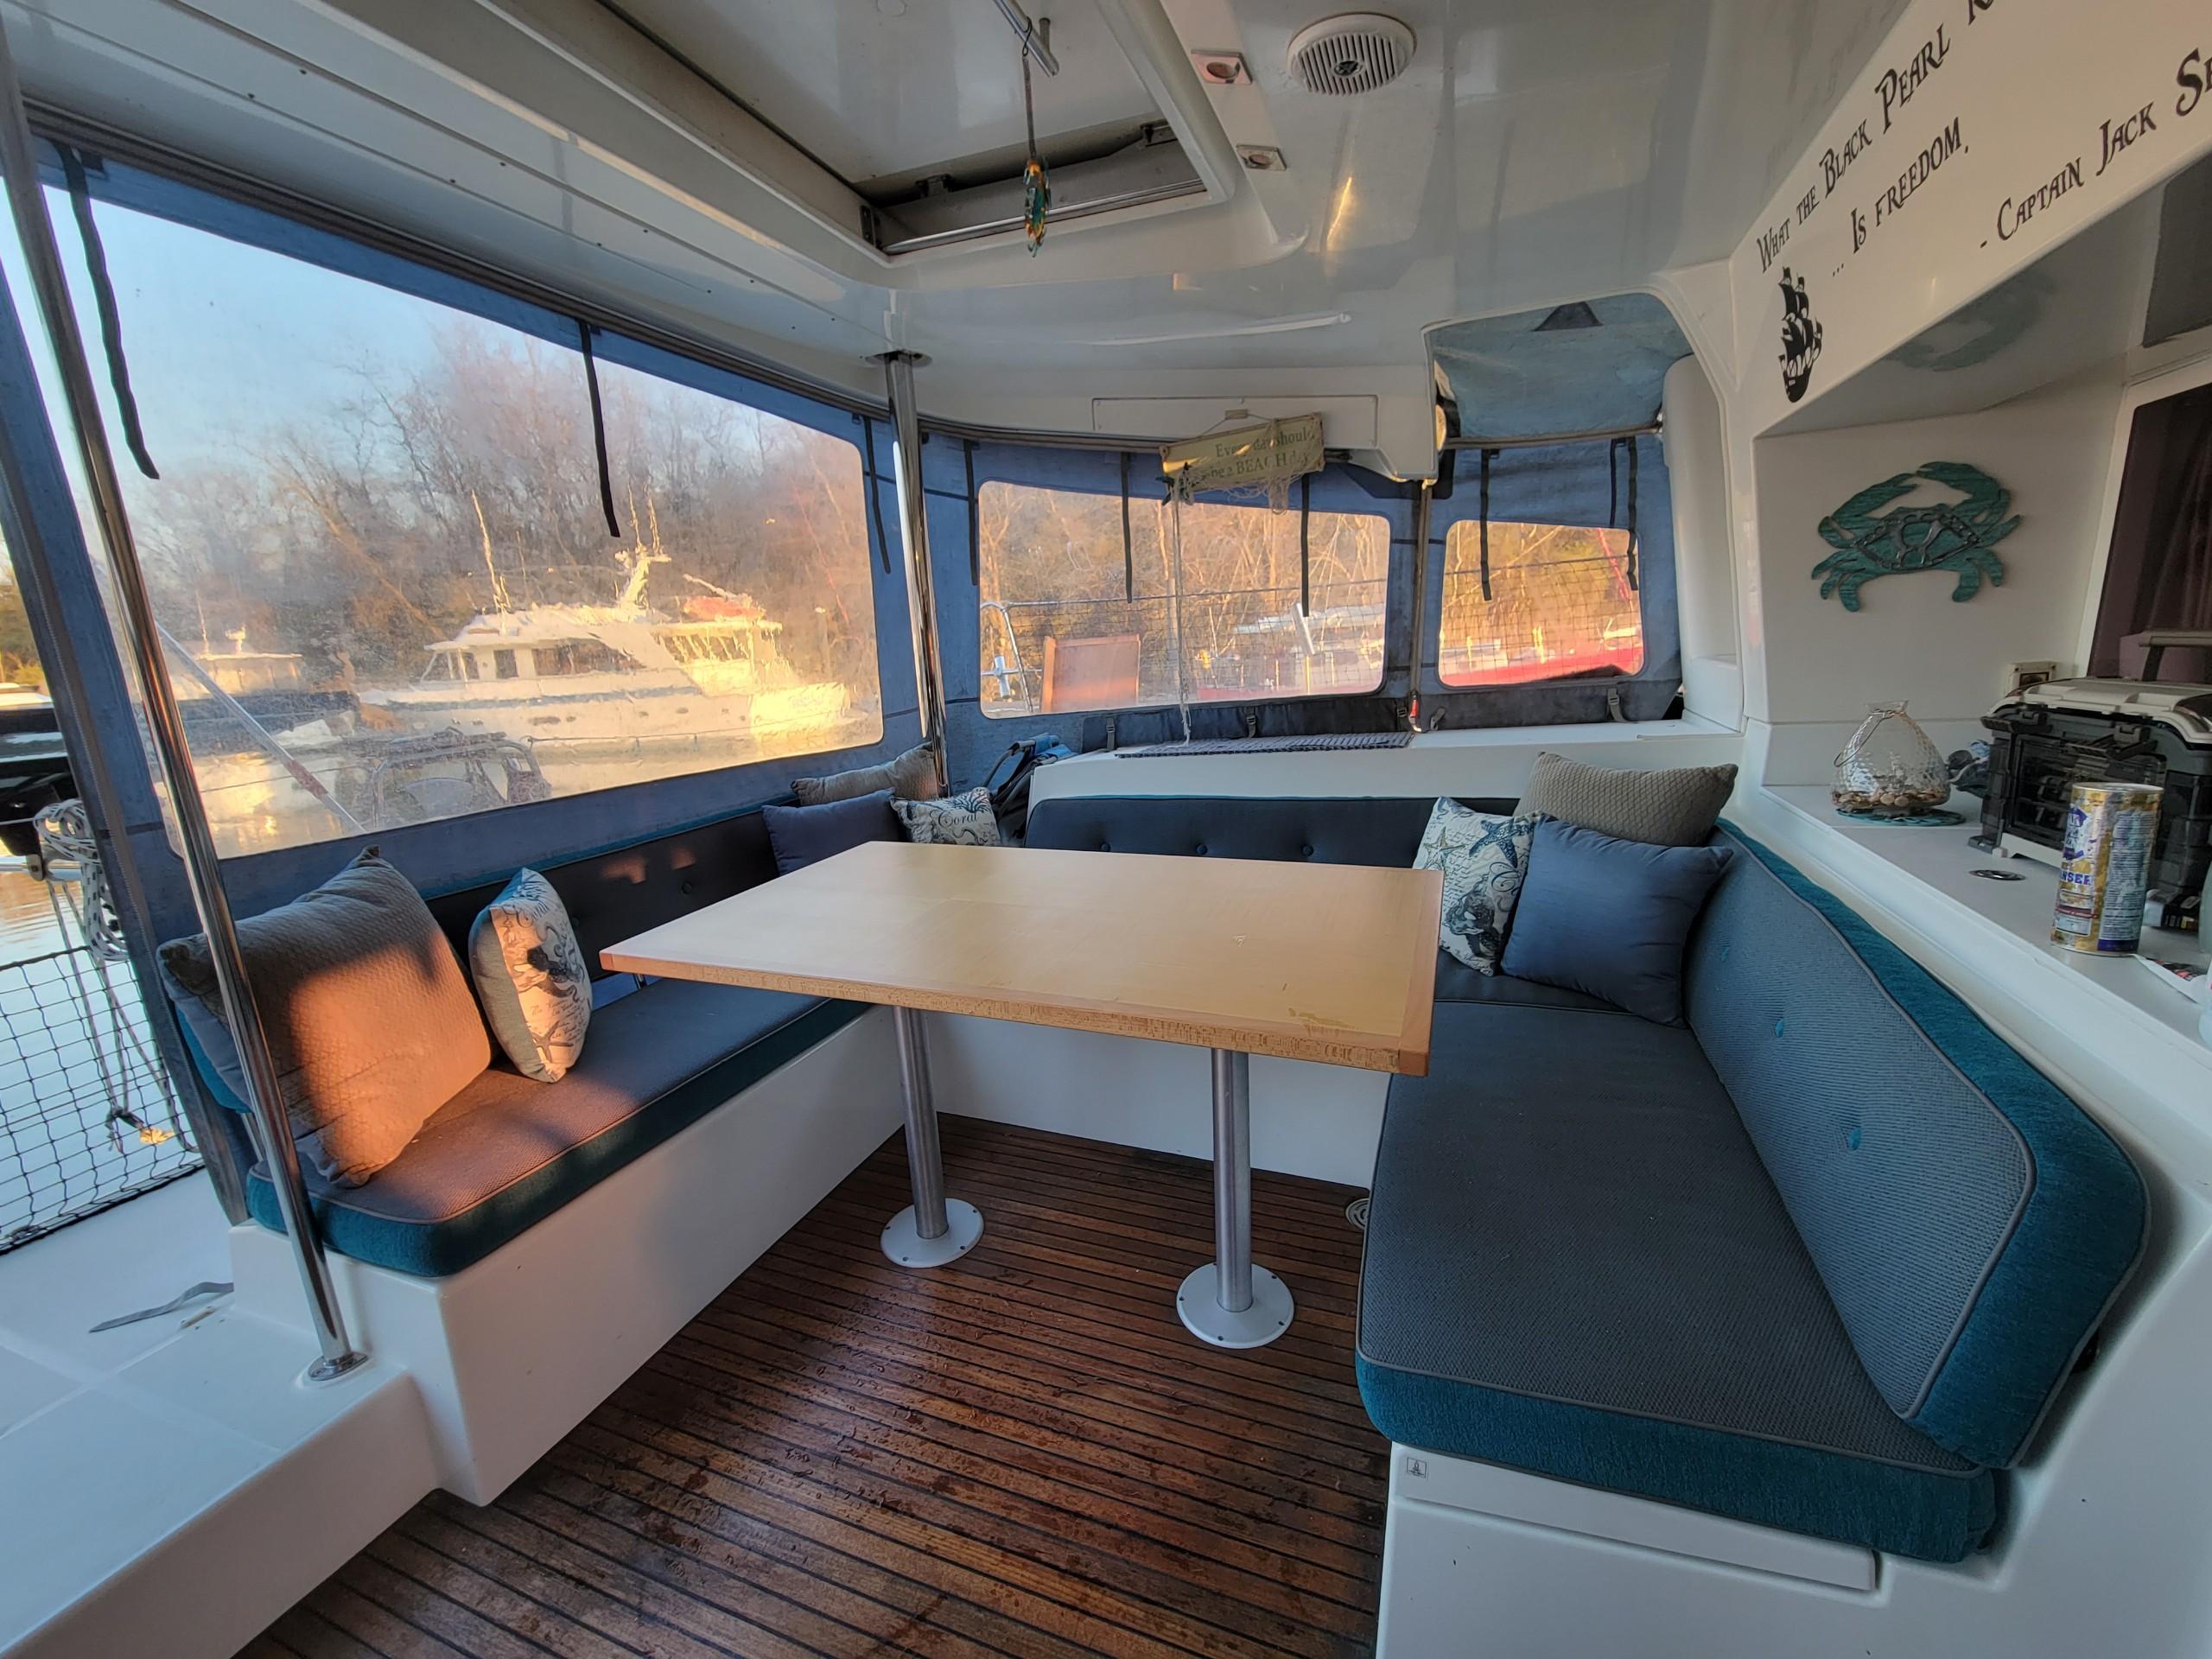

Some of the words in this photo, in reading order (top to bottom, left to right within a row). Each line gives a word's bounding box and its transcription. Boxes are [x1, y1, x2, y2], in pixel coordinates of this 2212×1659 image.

[1757, 218, 1790, 273] WHAT
[1796, 185, 1820, 226] THE
[1819, 118, 1872, 199] BLACK
[1874, 22, 1950, 135] PEARL
[1997, 156, 2084, 240] CAPTAIN
[2095, 101, 2157, 176] JACK
